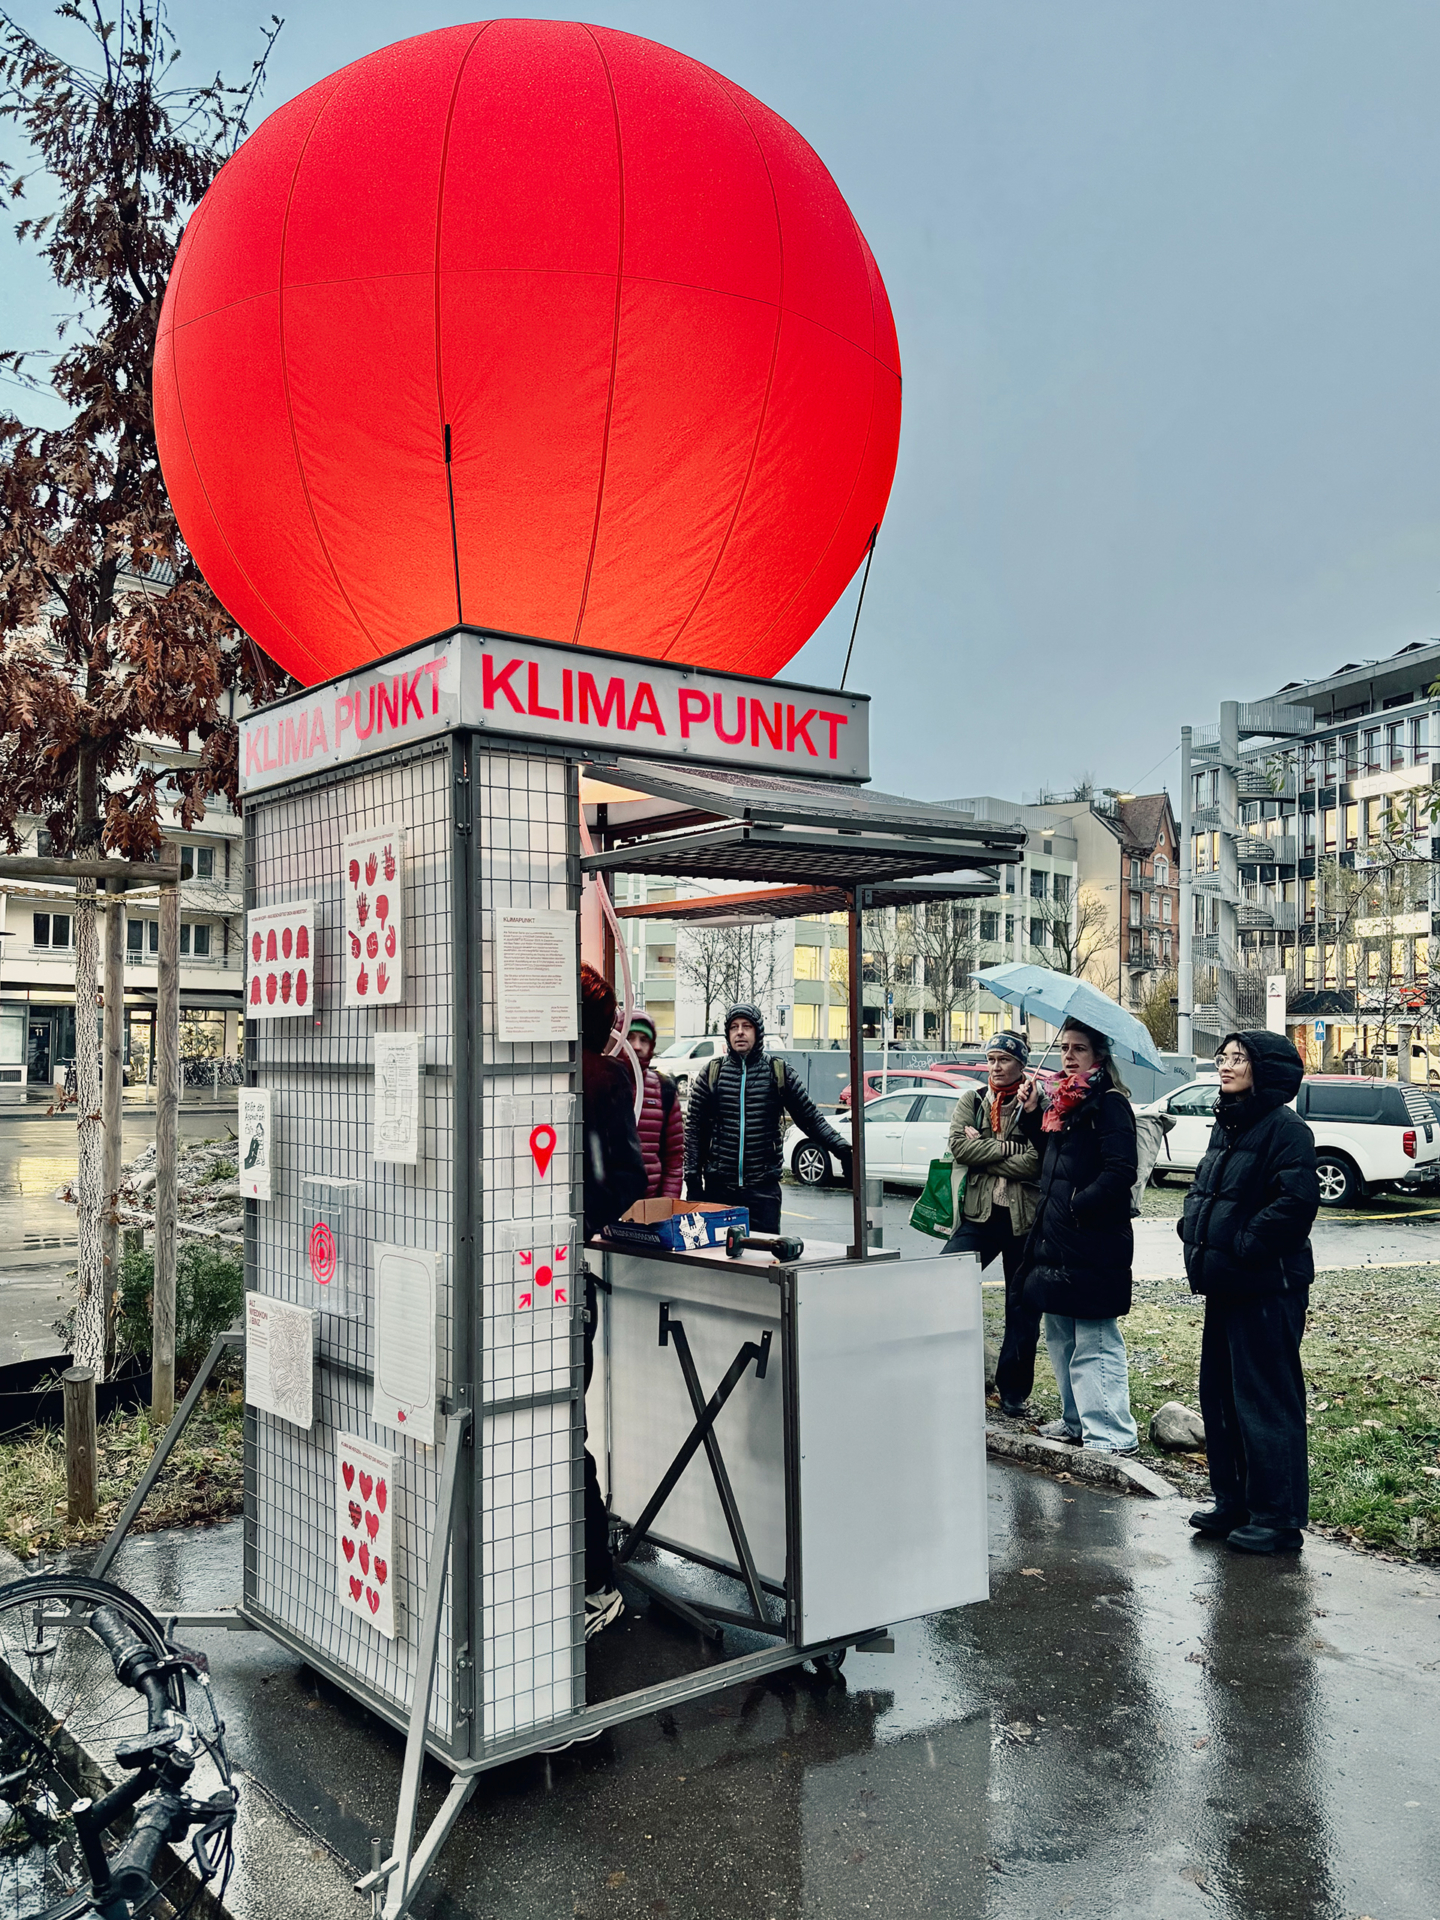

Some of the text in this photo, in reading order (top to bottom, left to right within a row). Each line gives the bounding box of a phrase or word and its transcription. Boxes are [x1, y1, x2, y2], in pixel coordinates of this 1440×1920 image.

[245, 656, 447, 777] KLIMA PUNKT
[482, 653, 848, 760] KLIMA PUNKT
[35, 1028, 43, 1037] 11
